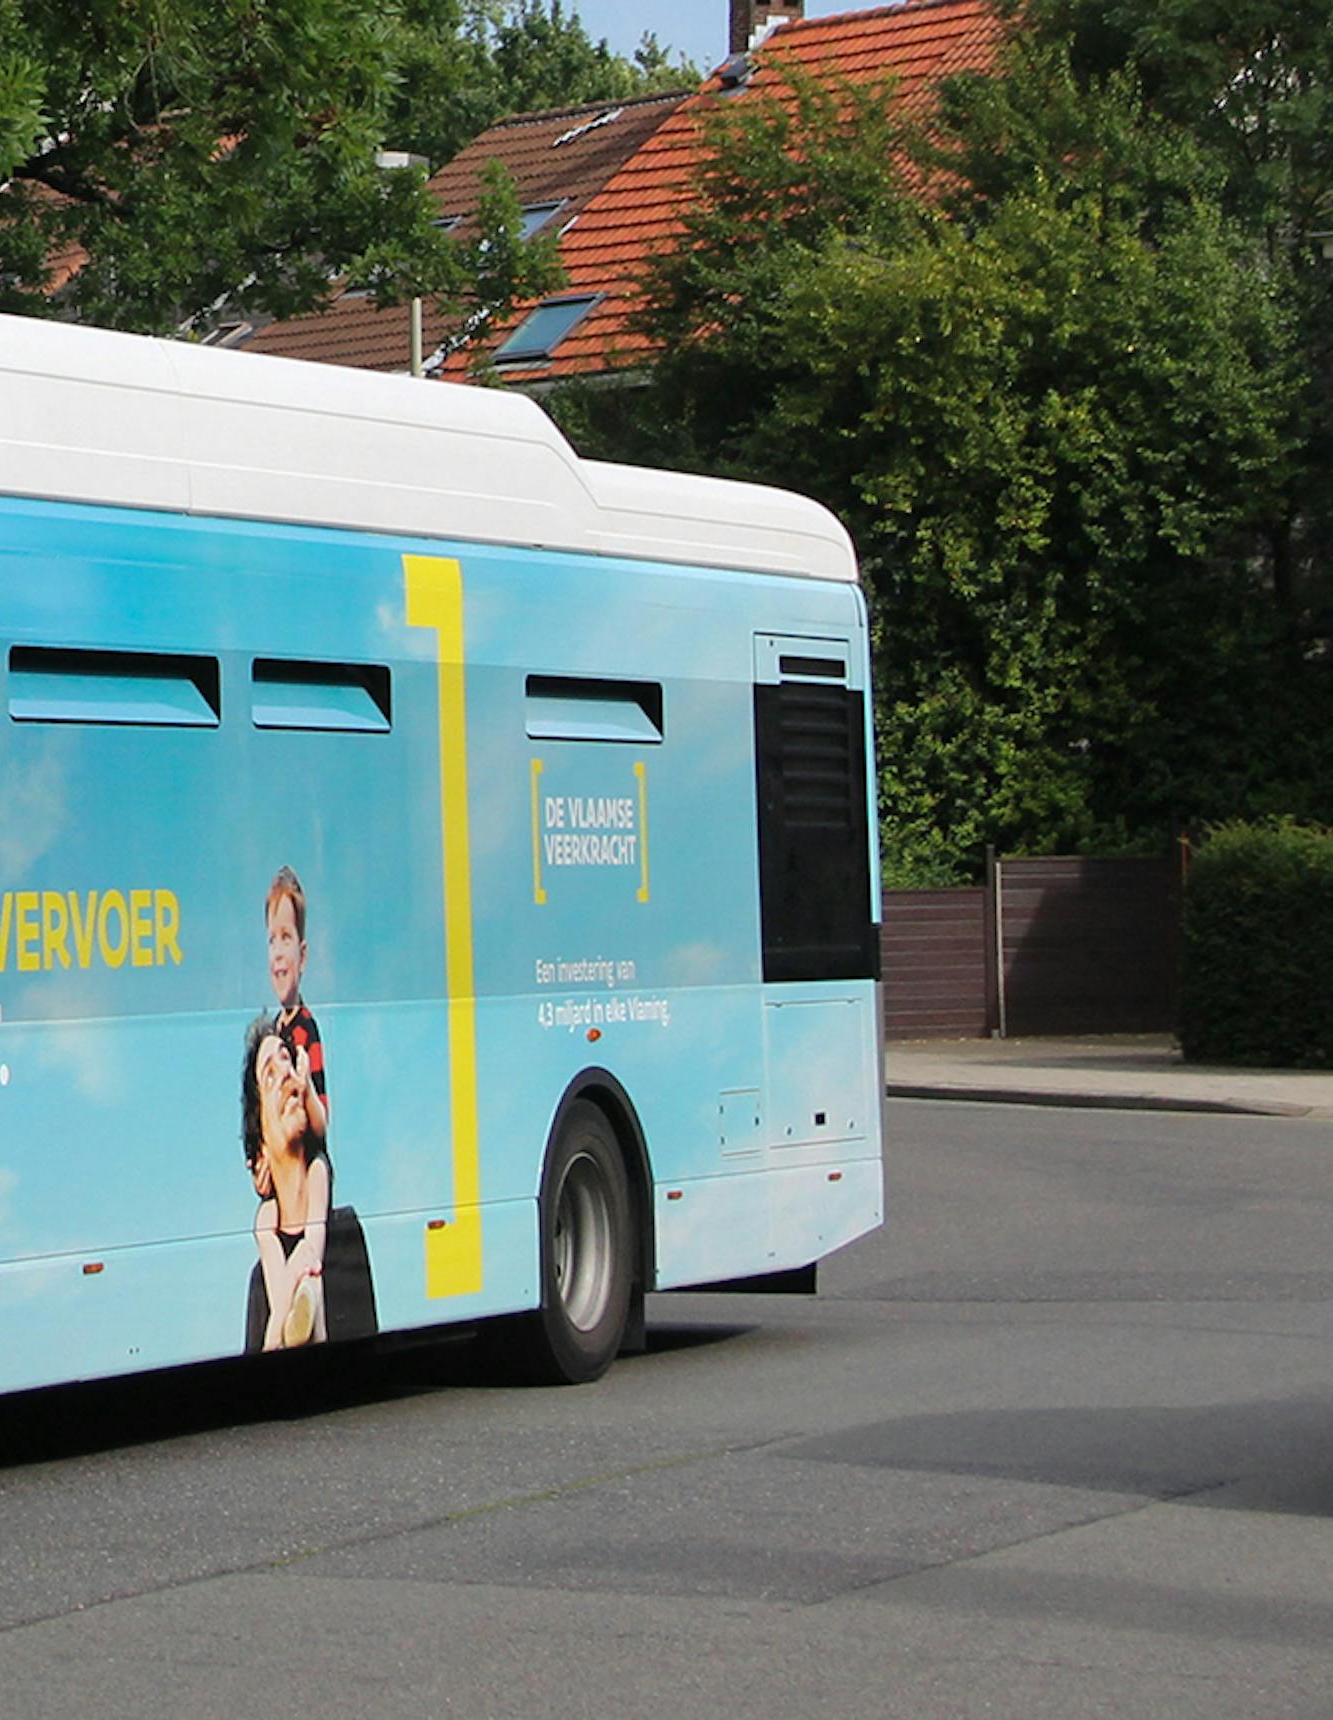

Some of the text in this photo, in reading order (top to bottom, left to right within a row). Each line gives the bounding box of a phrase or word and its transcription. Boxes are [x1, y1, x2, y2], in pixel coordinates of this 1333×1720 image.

[545, 797, 634, 829] DE VLAAMSE
[544, 834, 637, 865] VEERKRACHT
[536, 959, 555, 983] Een
[557, 955, 615, 988] investering
